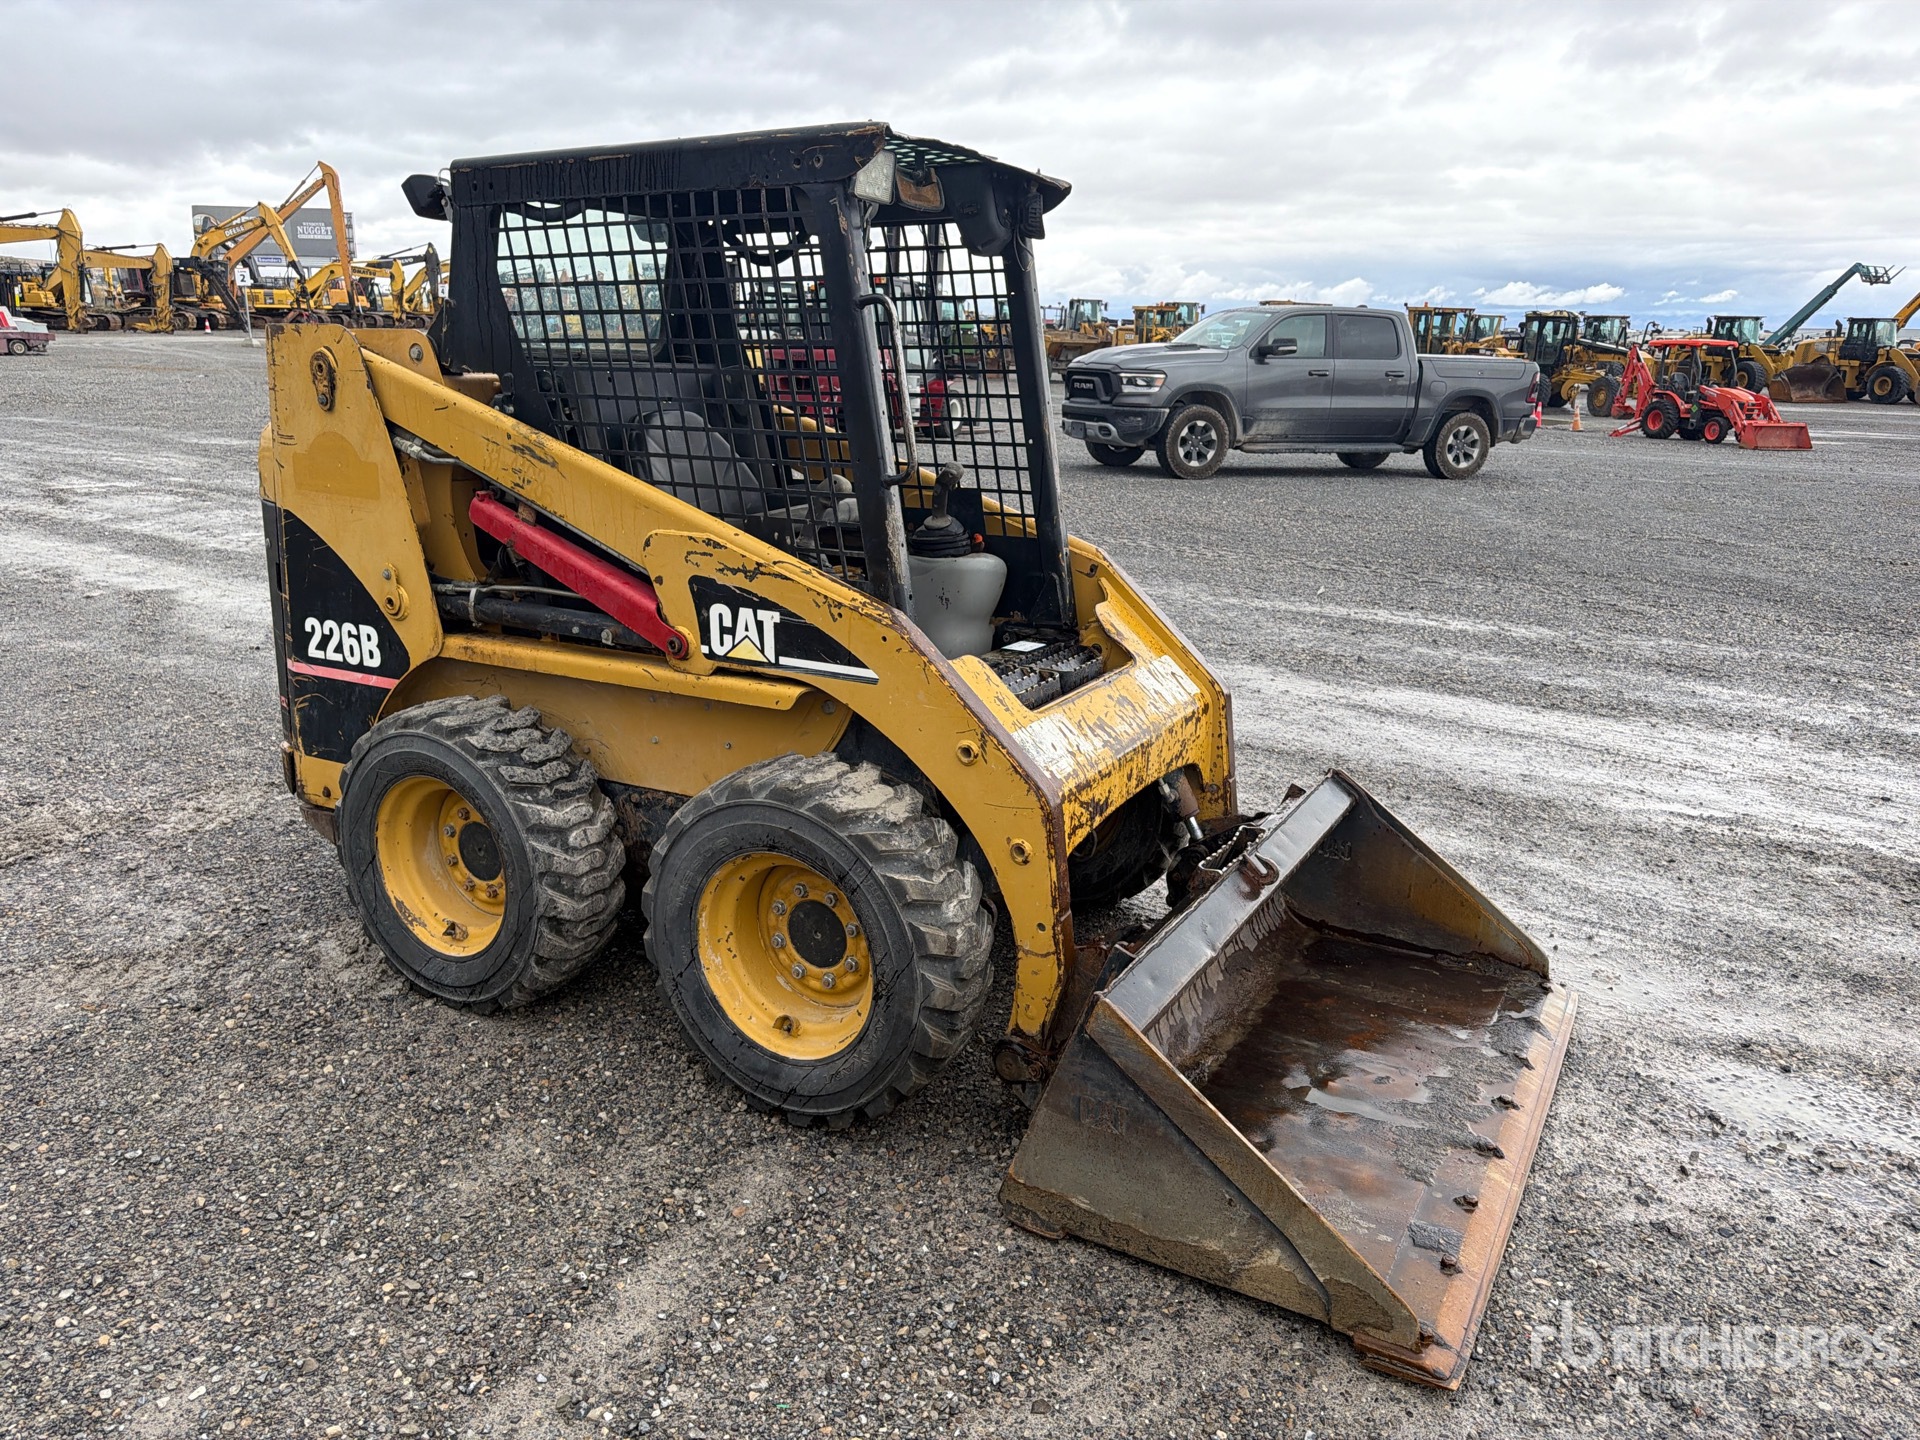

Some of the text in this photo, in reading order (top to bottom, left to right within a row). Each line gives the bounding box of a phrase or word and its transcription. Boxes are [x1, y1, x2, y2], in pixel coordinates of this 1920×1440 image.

[225, 225, 245, 237] DEERE
[297, 226, 333, 235] NUGGET
[352, 268, 377, 277] OMATSU
[240, 274, 246, 283] 2
[1507, 340, 1519, 350] CAT
[1073, 382, 1094, 390] RAM
[709, 603, 781, 664] CAT
[304, 616, 382, 668] 226B
